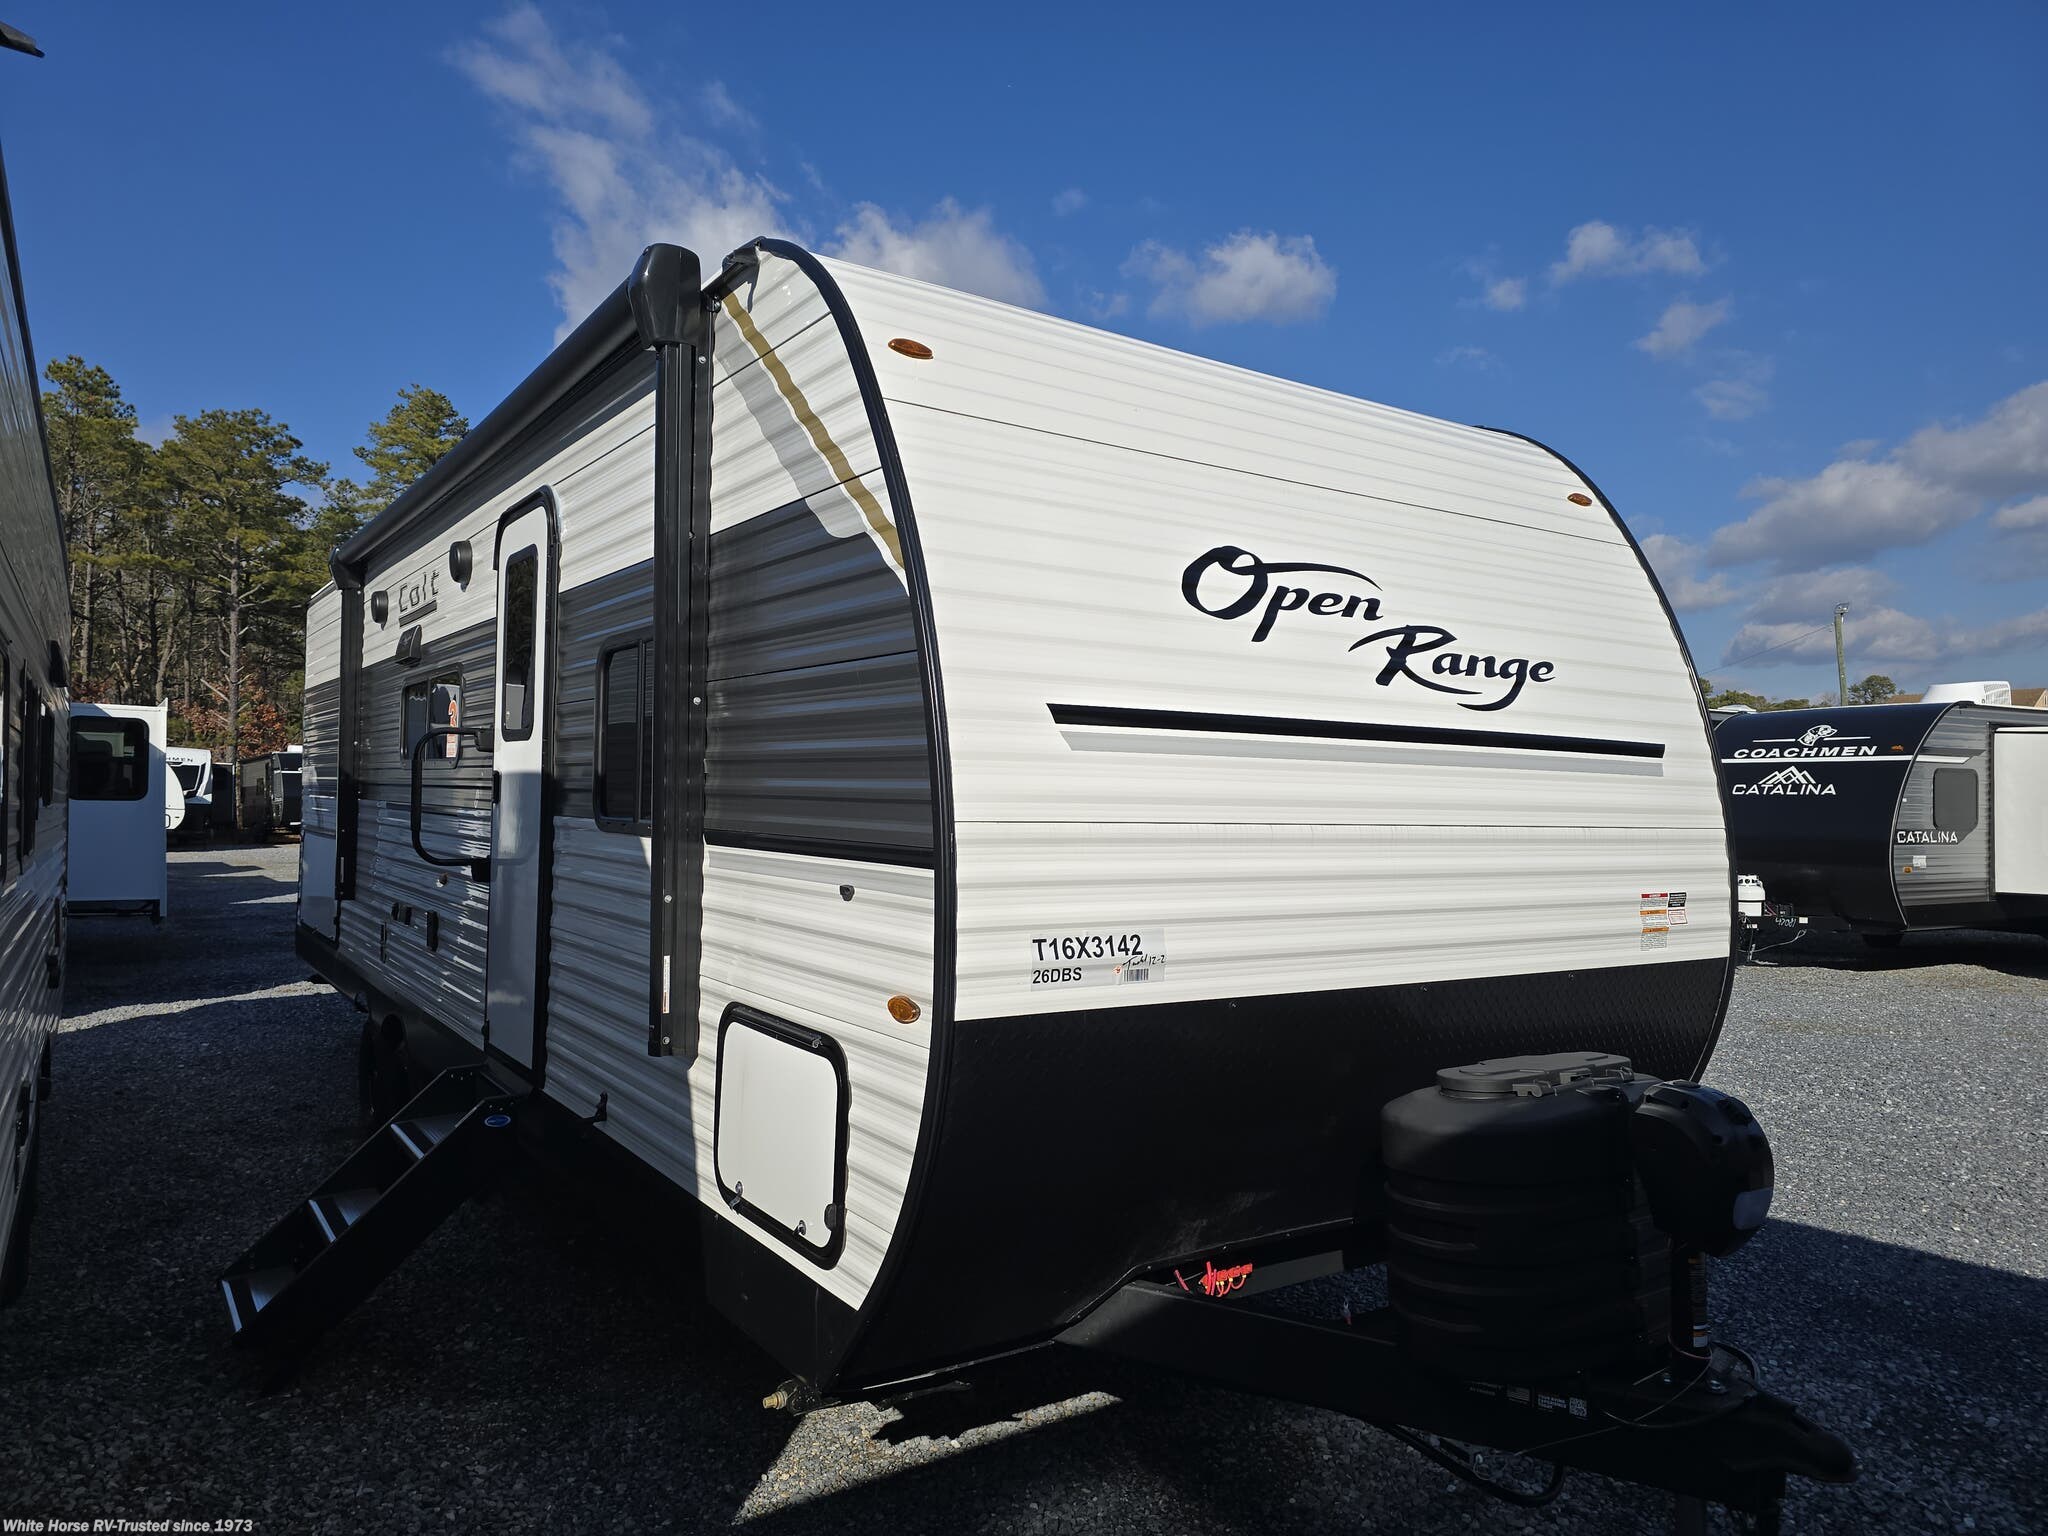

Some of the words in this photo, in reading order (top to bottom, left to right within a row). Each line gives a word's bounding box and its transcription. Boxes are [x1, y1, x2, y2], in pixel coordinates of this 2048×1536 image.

[399, 570, 439, 612] Colt
[1182, 546, 1383, 642] Open
[1347, 624, 1556, 711] Range
[1733, 745, 1878, 758] COACHMEN
[1732, 783, 1836, 795] CATALINA
[1897, 831, 1958, 843] CATALINA
[1032, 934, 1143, 961] T16X3142
[1032, 967, 1082, 984] 26DBS
